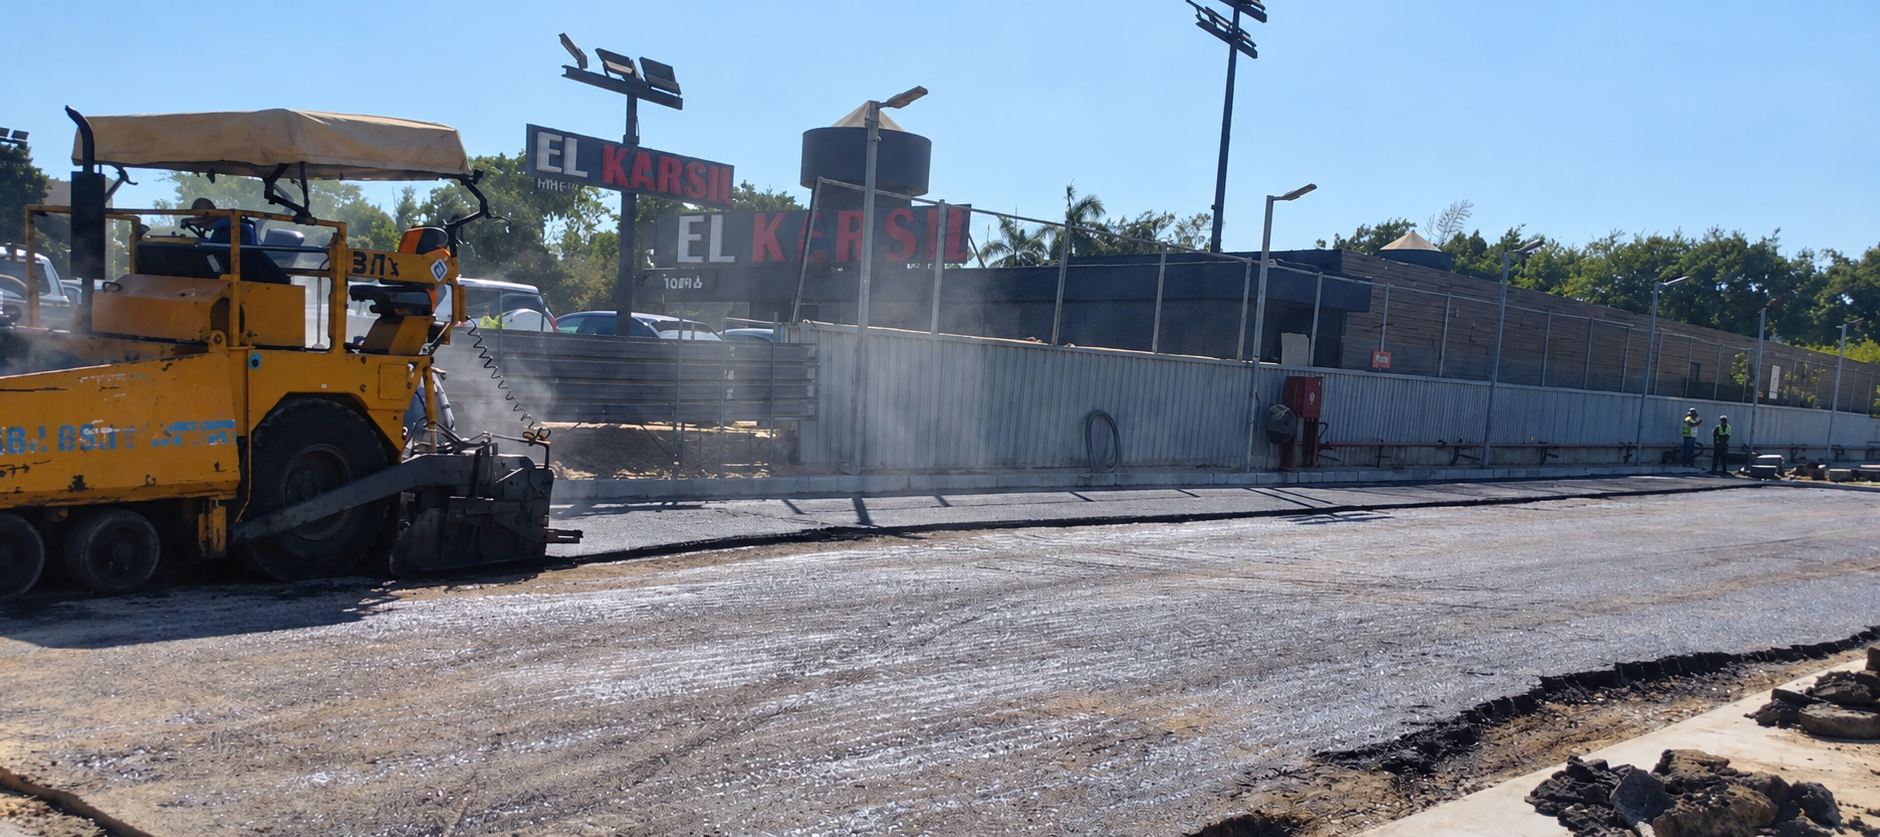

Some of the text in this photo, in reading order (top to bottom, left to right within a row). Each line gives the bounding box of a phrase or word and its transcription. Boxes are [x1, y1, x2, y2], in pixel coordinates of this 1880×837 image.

[536, 131, 734, 204] EL KARSIL
[677, 214, 735, 263] EL
